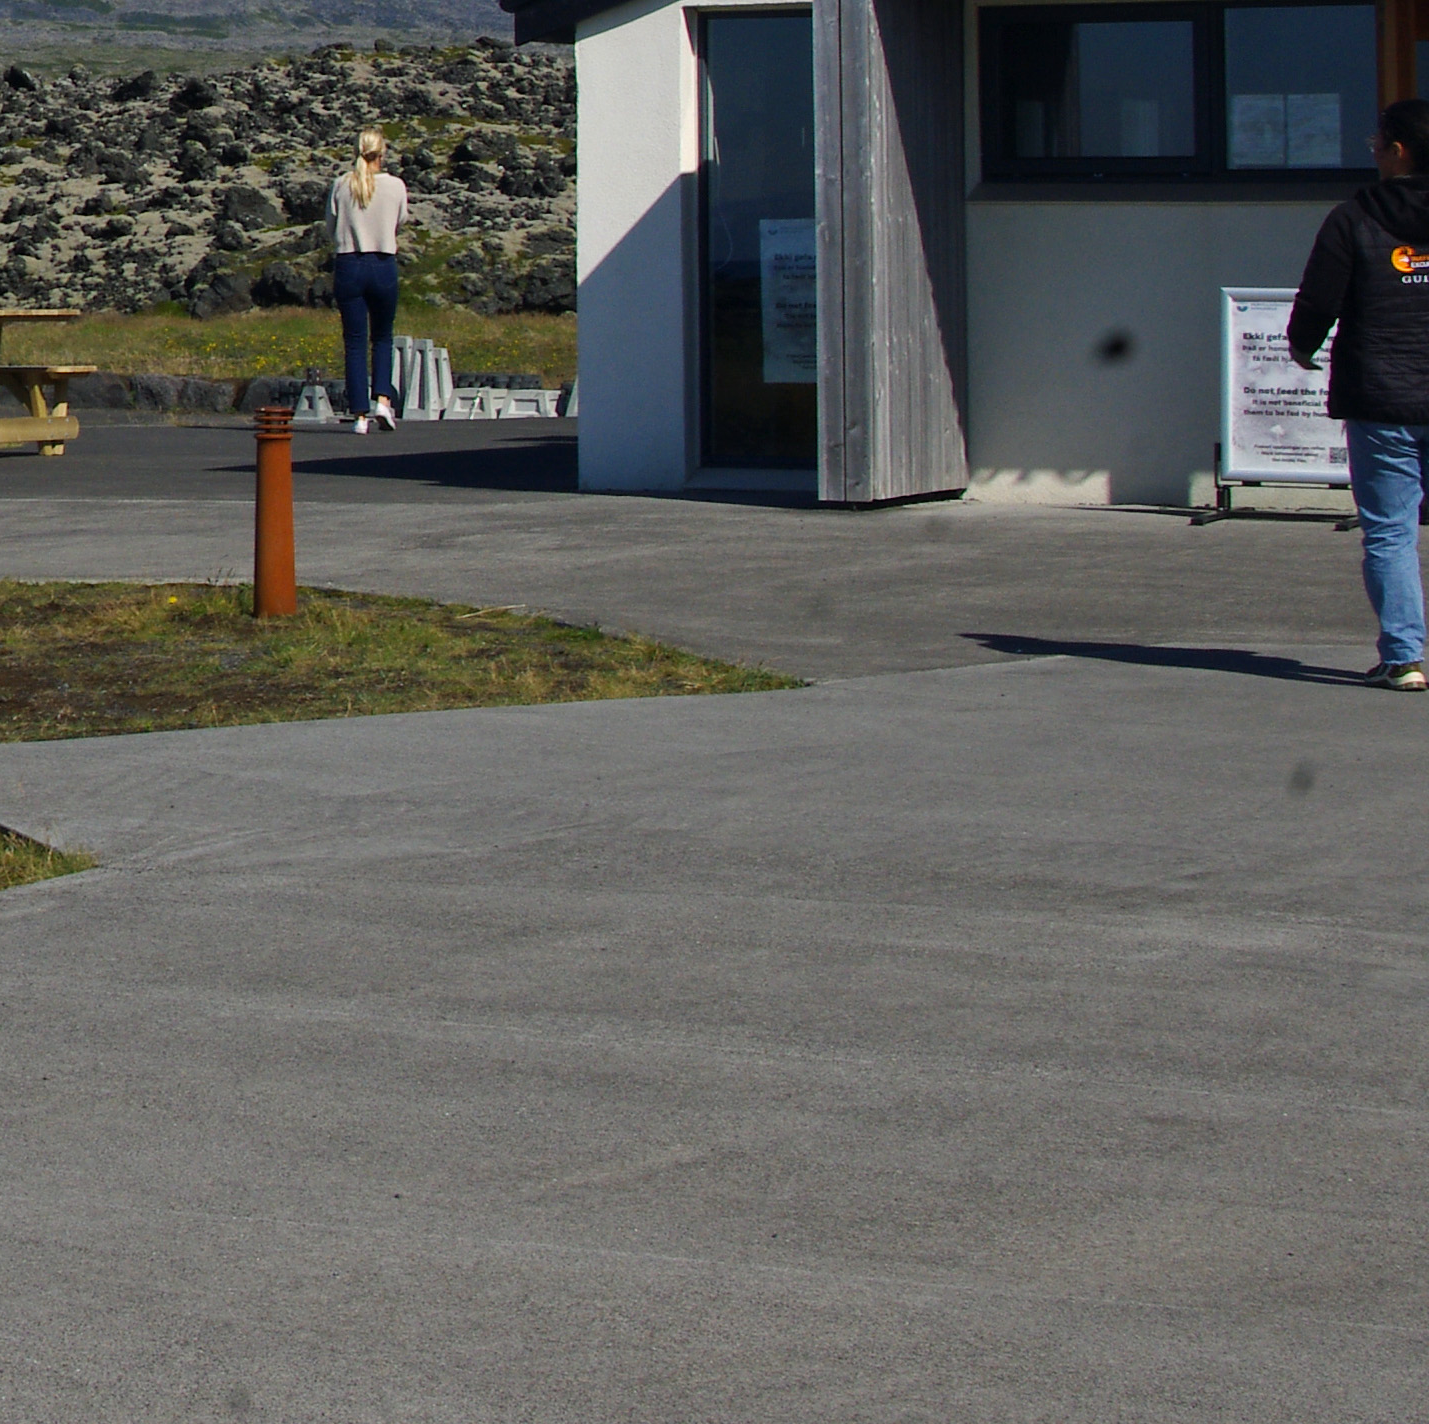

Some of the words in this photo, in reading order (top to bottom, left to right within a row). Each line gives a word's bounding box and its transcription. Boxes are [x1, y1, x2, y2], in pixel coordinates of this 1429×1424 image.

[1242, 332, 1264, 340] Ekki
[1243, 386, 1256, 395] Do
[1258, 387, 1274, 395] not
[1276, 387, 1298, 396] feed
[1300, 387, 1317, 396] the
[1319, 387, 1330, 396] fo
[1283, 399, 1321, 407] beneficial
